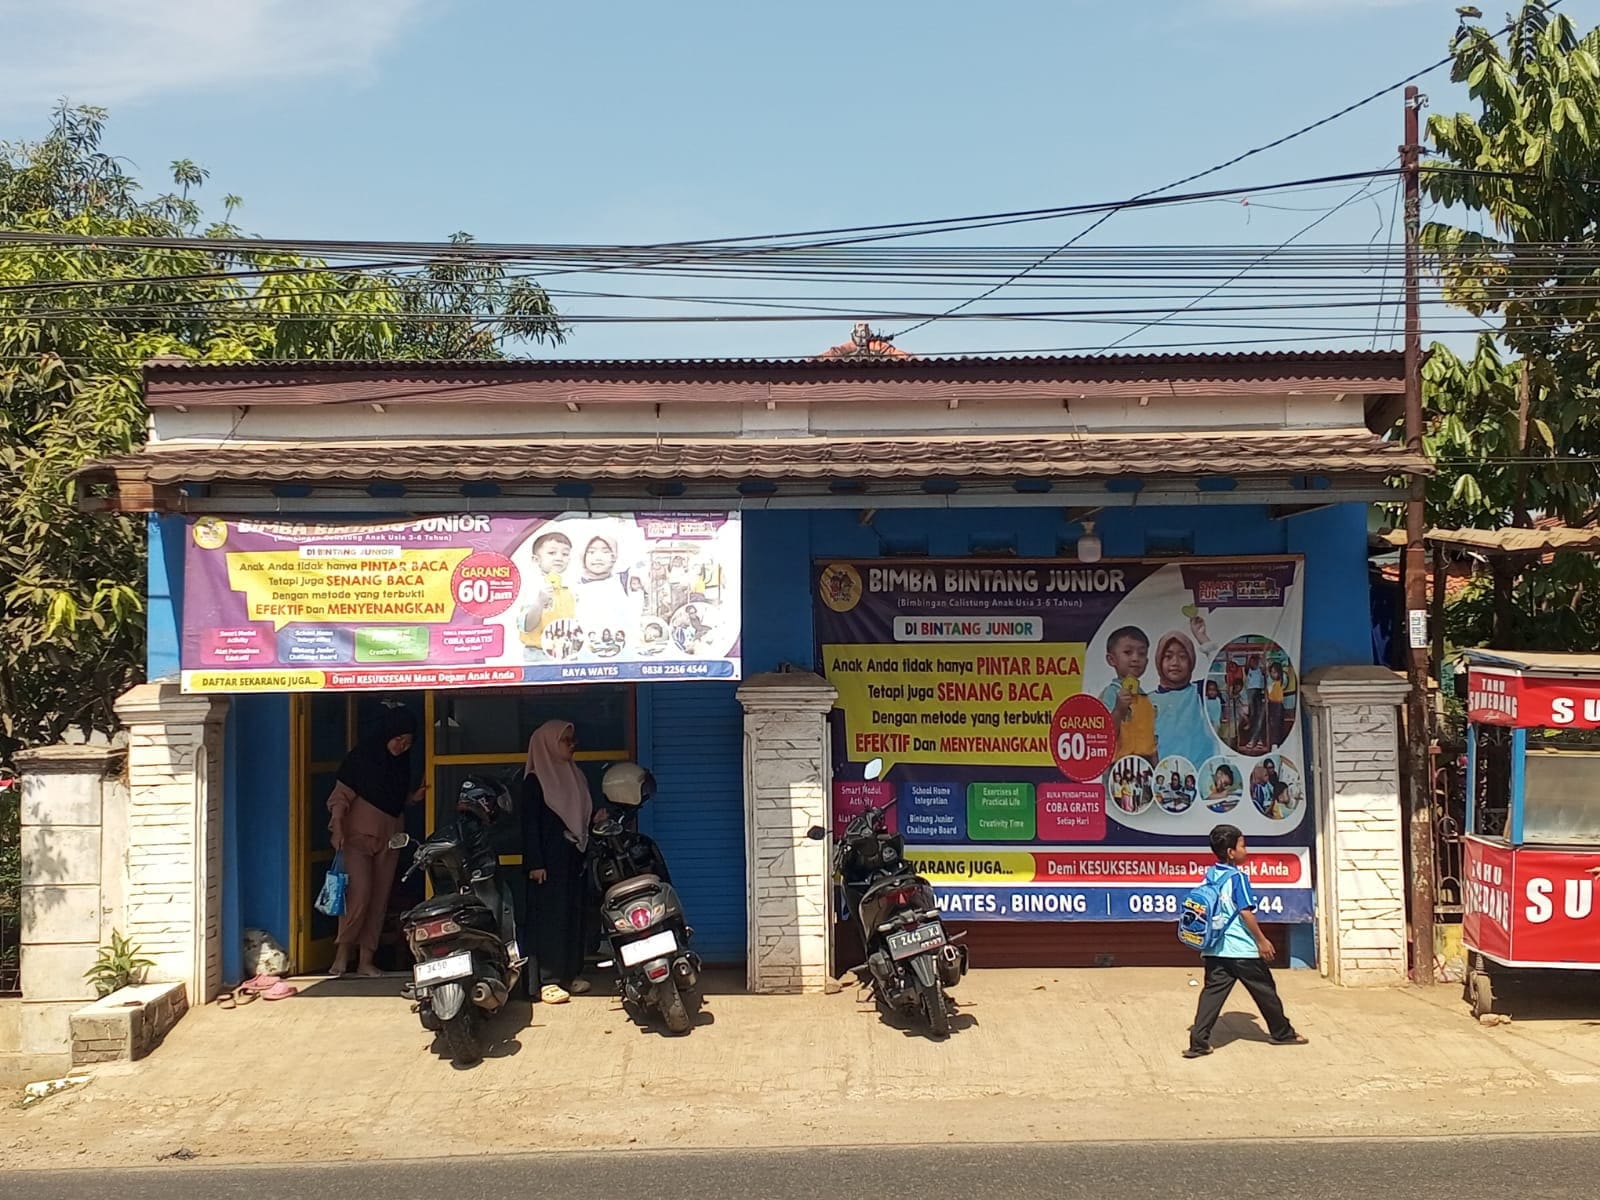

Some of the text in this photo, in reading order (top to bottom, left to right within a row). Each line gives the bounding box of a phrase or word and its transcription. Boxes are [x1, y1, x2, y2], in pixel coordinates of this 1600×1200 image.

[412, 515, 491, 533] JUNIOR
[240, 560, 448, 572] Anak Anda tidak hanya PINTAR BACA
[461, 566, 511, 578] GARANSI
[268, 577, 298, 587] Tetapi
[326, 575, 382, 587] SENANG
[387, 575, 424, 586] BACA
[869, 568, 1126, 593] BIMBA BINTANG JUNIOR
[272, 590, 425, 601] Dengan metode yang terbukti
[458, 579, 489, 603] 60
[256, 603, 445, 615] EFEKTIF Dan MENYENANGKAN
[897, 599, 1083, 608] (Bimbingan Calistung Anak Usia 3-6 Tahun)
[905, 622, 1033, 636] DI BINTANG JUNIOR
[562, 666, 586, 677] RAYA
[588, 666, 618, 676] WATES
[832, 656, 1080, 676] Anak Anda tidak hanya PINTAR BACA
[202, 678, 237, 686] DAFTAR
[239, 677, 287, 686] SEKARANG
[332, 670, 515, 684] Demi KESUKSESAN Masa Depan Anak Anda
[868, 684, 904, 701] Tetapi
[937, 681, 1004, 702] SENANG
[1008, 682, 1053, 702] BACA
[1481, 678, 1505, 693] TAHU
[1468, 691, 1518, 719] SUMEDANG
[872, 710, 1052, 727] Dengan metode yang terbukti
[1060, 716, 1105, 729] GARANSI
[855, 732, 1048, 753] EFEKTIF Dan MENYENANGKAN
[1057, 732, 1085, 761] 60
[912, 786, 951, 795] School Home
[983, 787, 1010, 796] Exercises
[914, 796, 948, 806] Integration
[981, 798, 1021, 807] Practical Life
[1046, 802, 1100, 813] COBA GRATIS
[909, 814, 954, 824] Bintang Junior
[979, 819, 1024, 829] Creativity Time
[1057, 816, 1076, 827] Setiap
[906, 825, 957, 836] Challenge Board
[911, 860, 1013, 878] KARANG JUGA...
[1047, 861, 1077, 876] Demi
[1079, 860, 1156, 876] KESUKSESAN
[1158, 861, 1187, 876] Masa
[1259, 860, 1290, 877] Anda
[934, 894, 997, 913] WATES
[1011, 894, 1087, 913] BINONG
[1129, 895, 1177, 913] 0838
